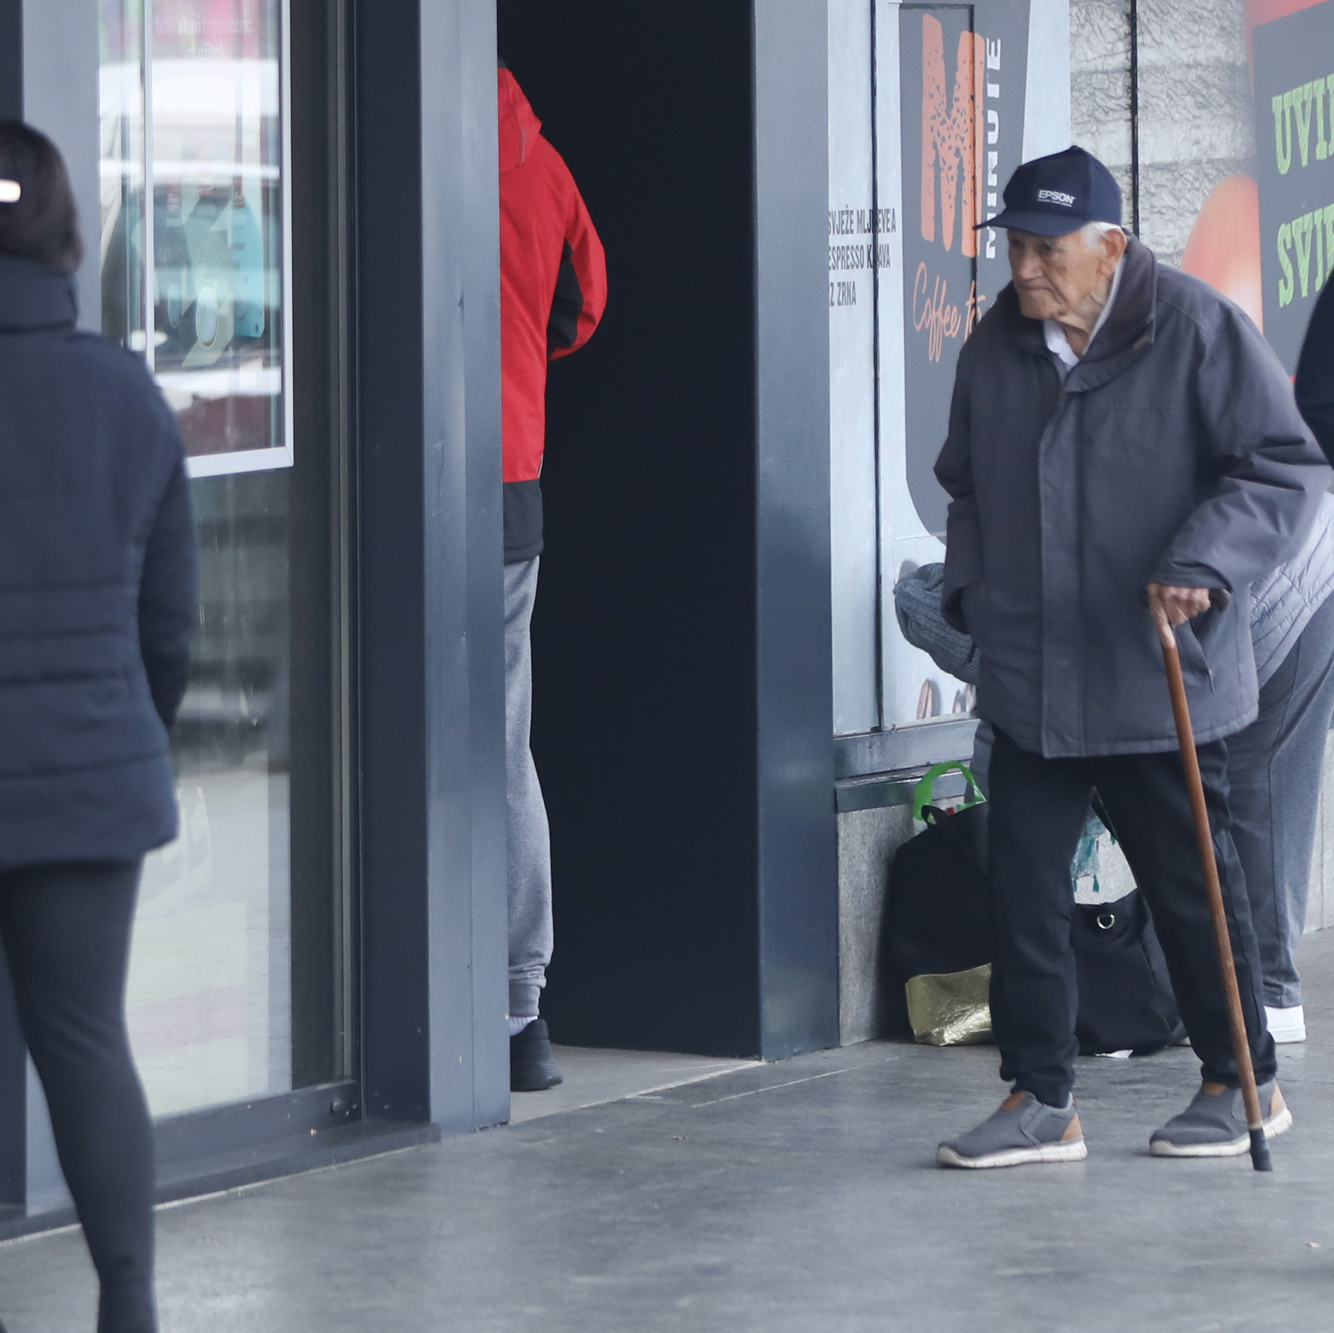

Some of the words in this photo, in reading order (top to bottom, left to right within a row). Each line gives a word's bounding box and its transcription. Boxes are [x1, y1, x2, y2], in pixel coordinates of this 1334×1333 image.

[1038, 189, 1074, 205] EPSON
[837, 280, 857, 307] ZRNA
[913, 261, 961, 363] Coffee
